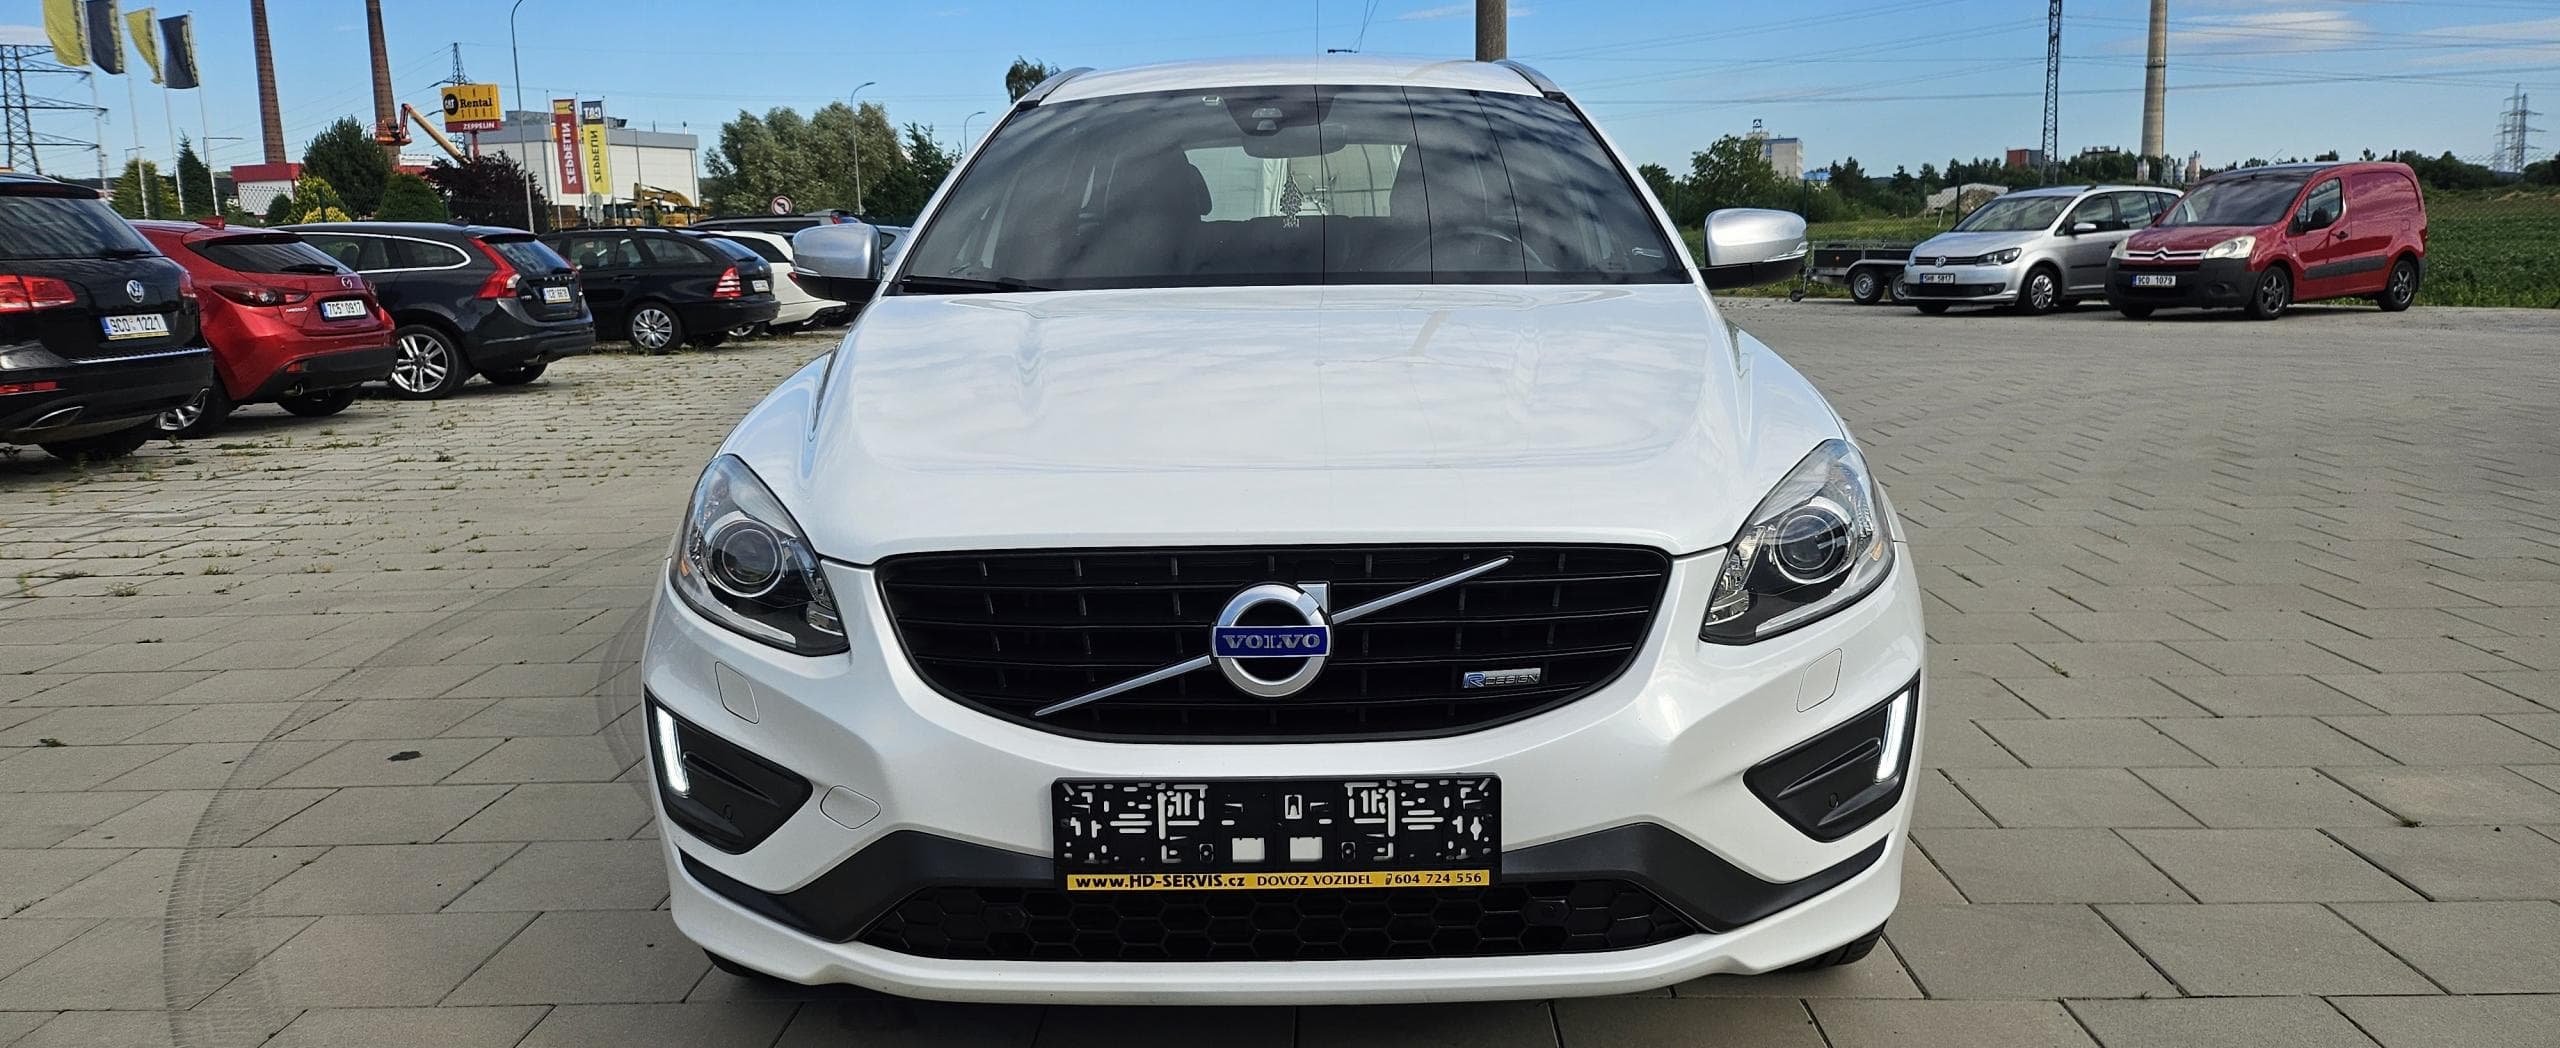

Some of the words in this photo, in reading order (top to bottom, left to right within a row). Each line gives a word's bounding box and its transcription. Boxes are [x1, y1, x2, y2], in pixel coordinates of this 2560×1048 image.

[460, 98, 493, 108] Rental
[463, 121, 495, 130] ZEPPELIN
[136, 316, 161, 331] 1221
[1222, 633, 1321, 649] VOLVO
[1075, 874, 1246, 889] www.HD-SERVIS.cz
[1257, 875, 1308, 886] DOVOZ
[1313, 874, 1373, 886] VOZIDEL
[1395, 874, 1420, 884] 604
[1426, 873, 1450, 884] 724
[1456, 873, 1482, 883] 556
